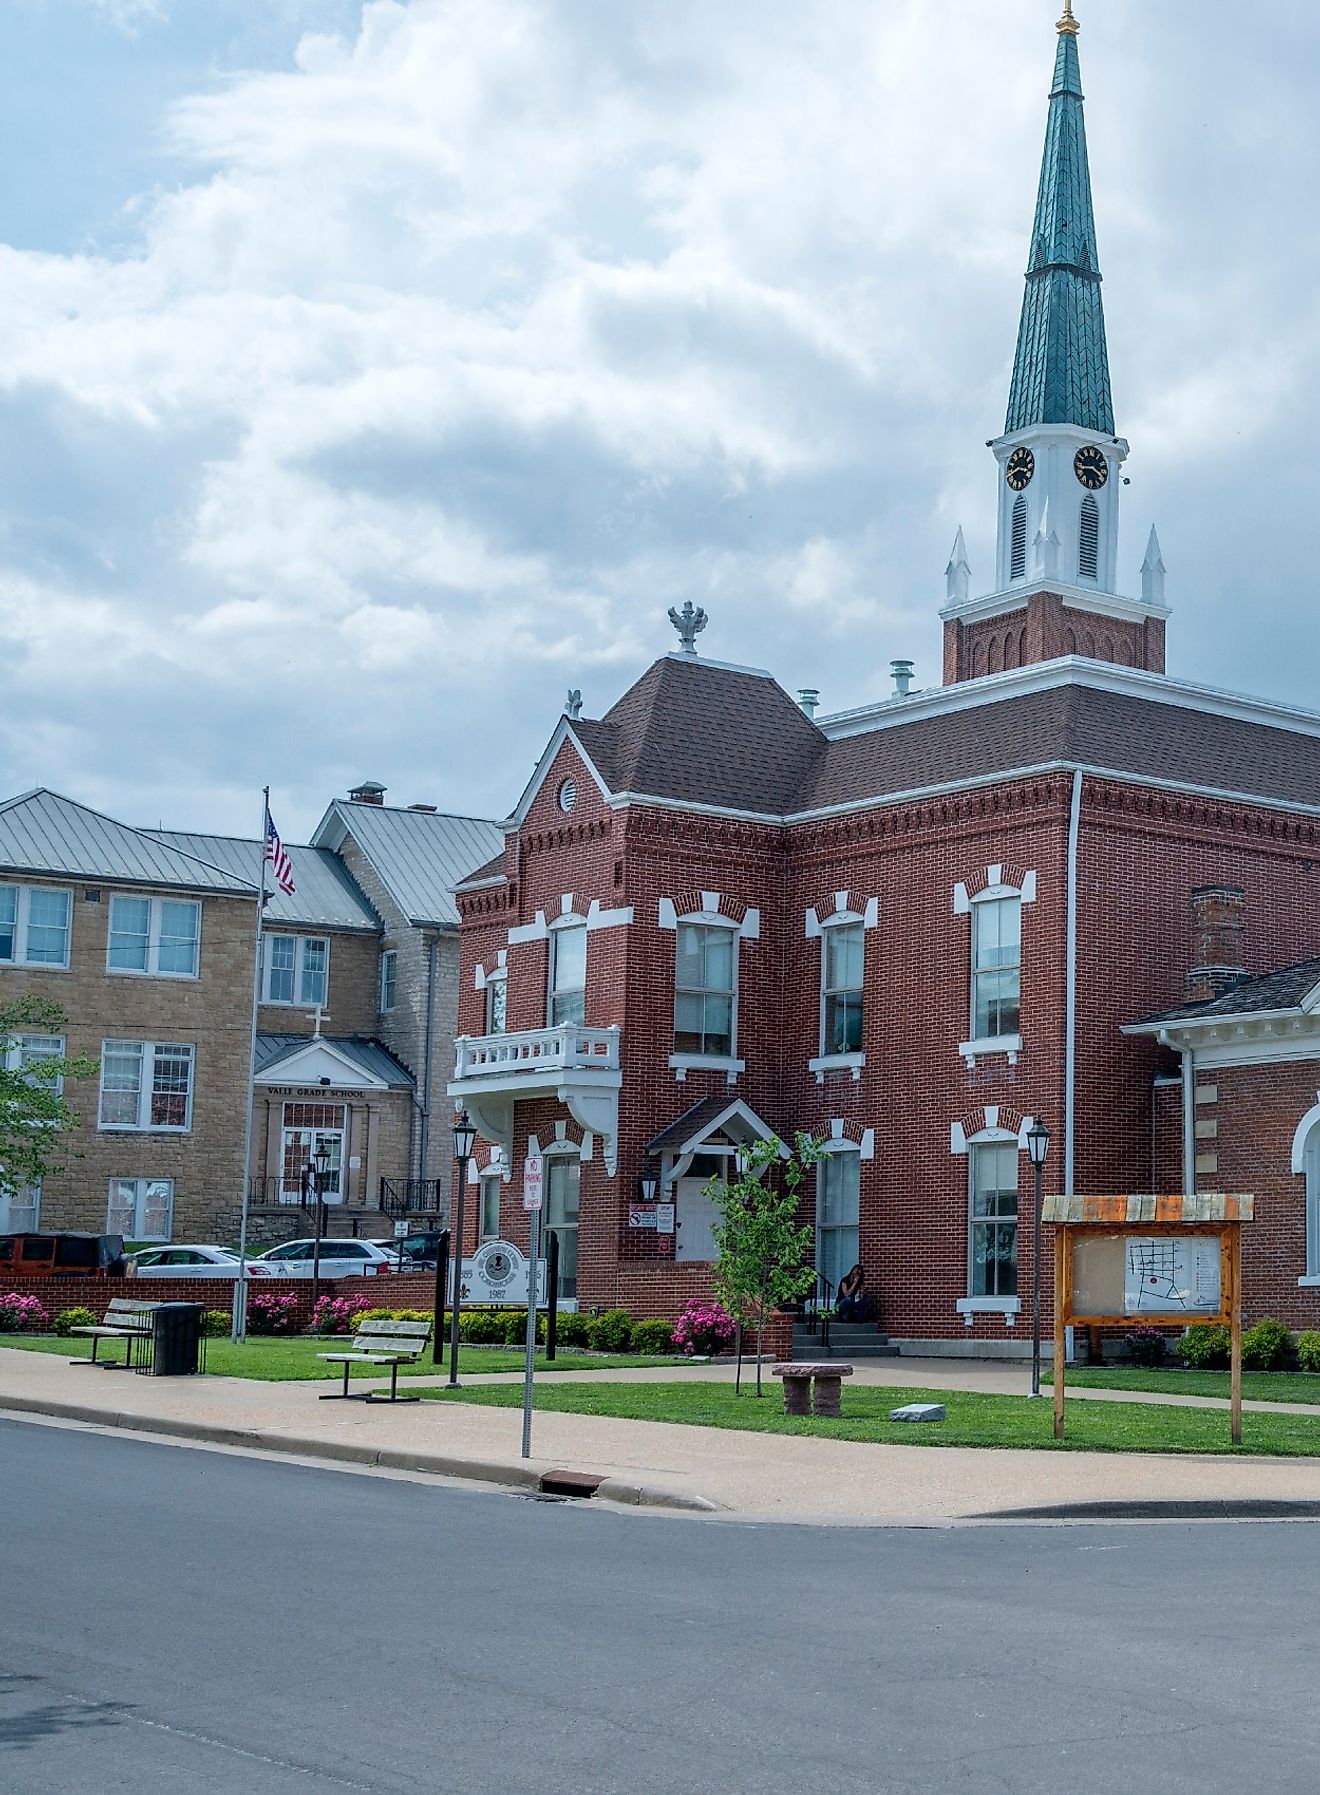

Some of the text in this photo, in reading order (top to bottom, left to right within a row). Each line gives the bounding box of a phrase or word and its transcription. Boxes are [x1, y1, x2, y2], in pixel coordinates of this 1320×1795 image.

[268, 1087, 365, 1098] VALLE GRADE SCHOOL
[489, 1289, 506, 1299] 1987
